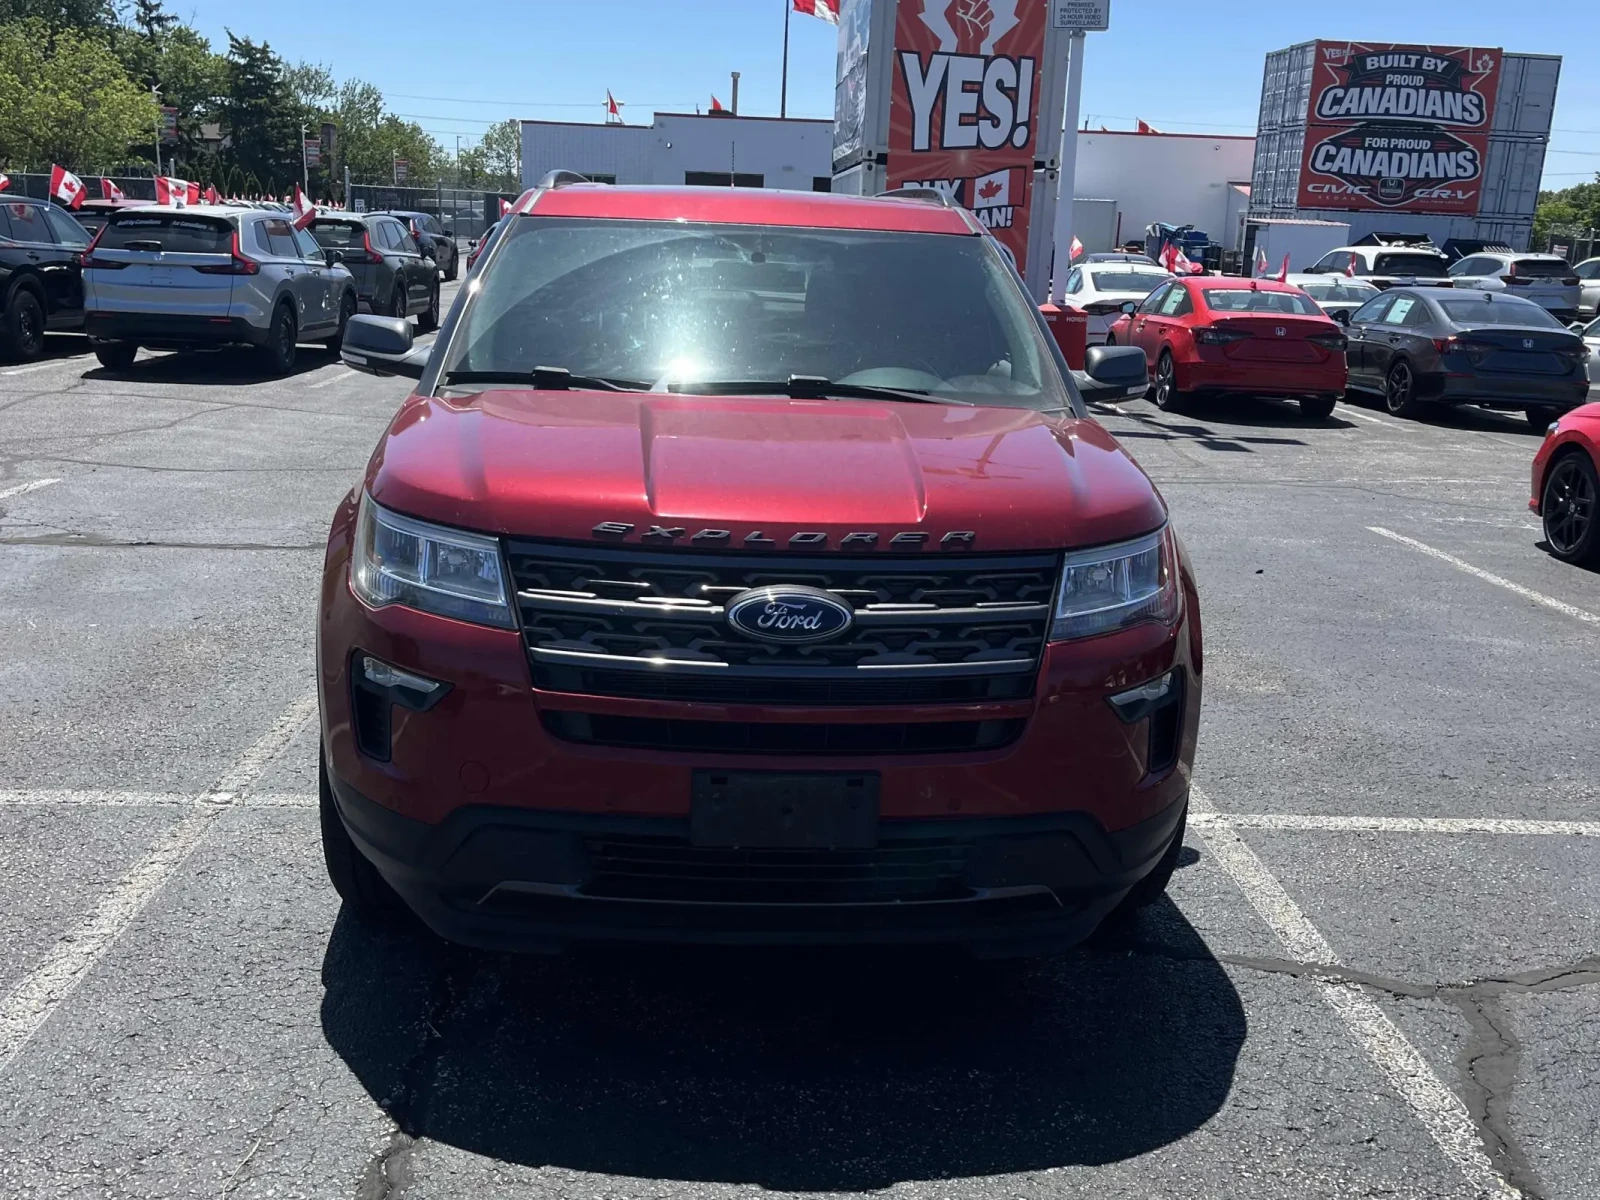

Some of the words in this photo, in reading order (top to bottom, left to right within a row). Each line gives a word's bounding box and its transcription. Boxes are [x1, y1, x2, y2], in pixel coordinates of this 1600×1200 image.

[1366, 54, 1420, 70] BUILT
[1422, 56, 1449, 73] BY
[1385, 74, 1424, 87] PROUD
[901, 52, 1035, 151] YES!
[1321, 86, 1480, 122] CANADIANS
[1365, 137, 1389, 148] FOR
[1390, 138, 1431, 150] PROUD
[1314, 144, 1475, 179] CANADIANS
[1306, 183, 1371, 195] CIVIC
[1414, 188, 1477, 199] CR-V
[592, 521, 976, 546] EXPLORER
[757, 601, 823, 630] Ford
